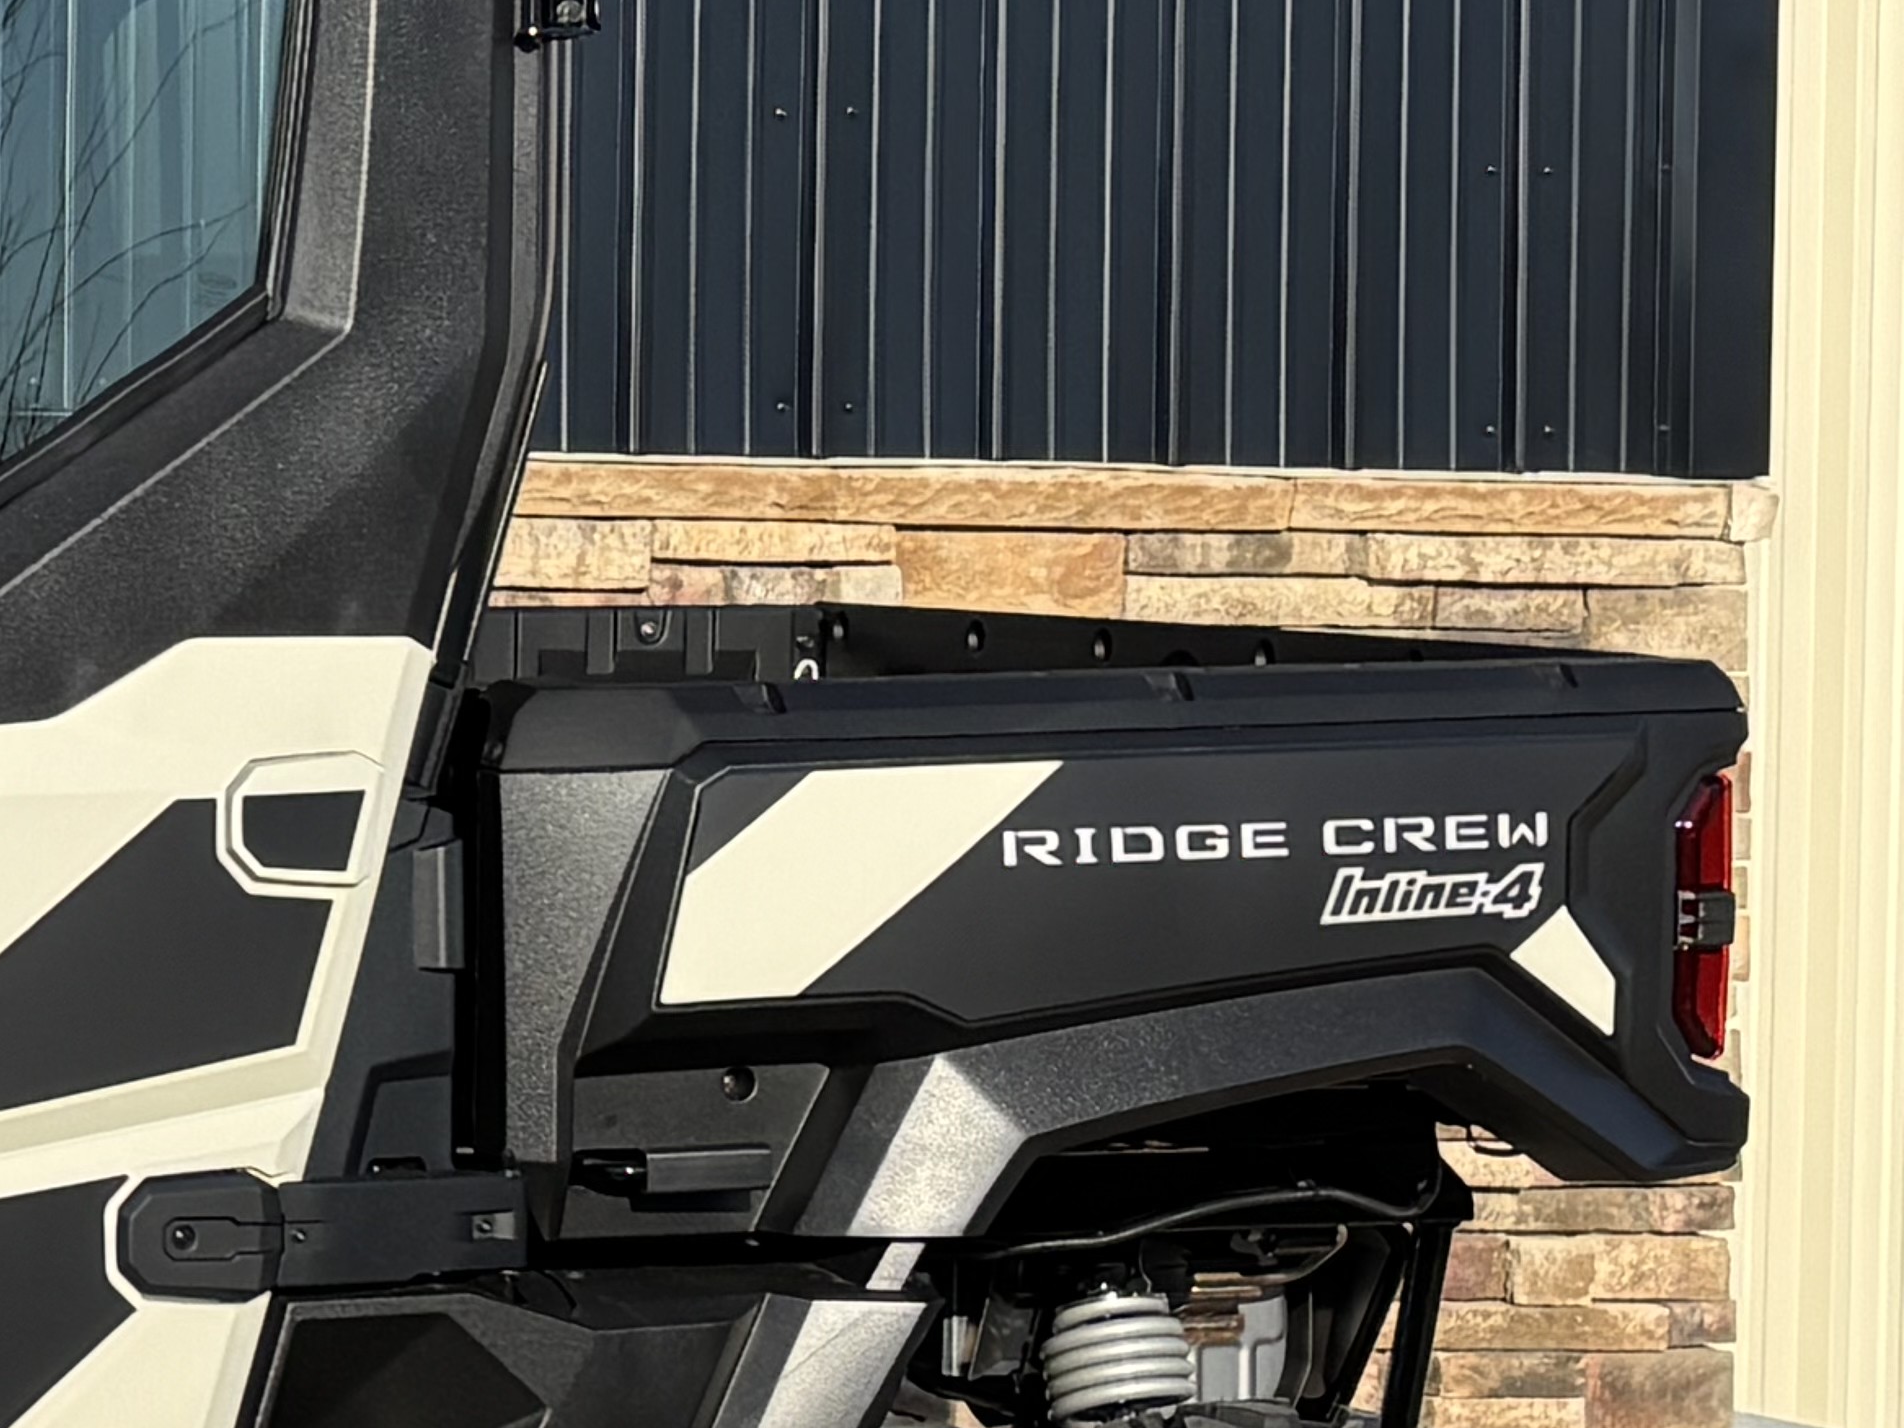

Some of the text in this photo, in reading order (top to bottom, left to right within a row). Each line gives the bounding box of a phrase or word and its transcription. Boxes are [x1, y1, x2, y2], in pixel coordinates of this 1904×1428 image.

[1002, 811, 1549, 867] RIDGE CREW
[1319, 861, 1545, 926] Inline-4
